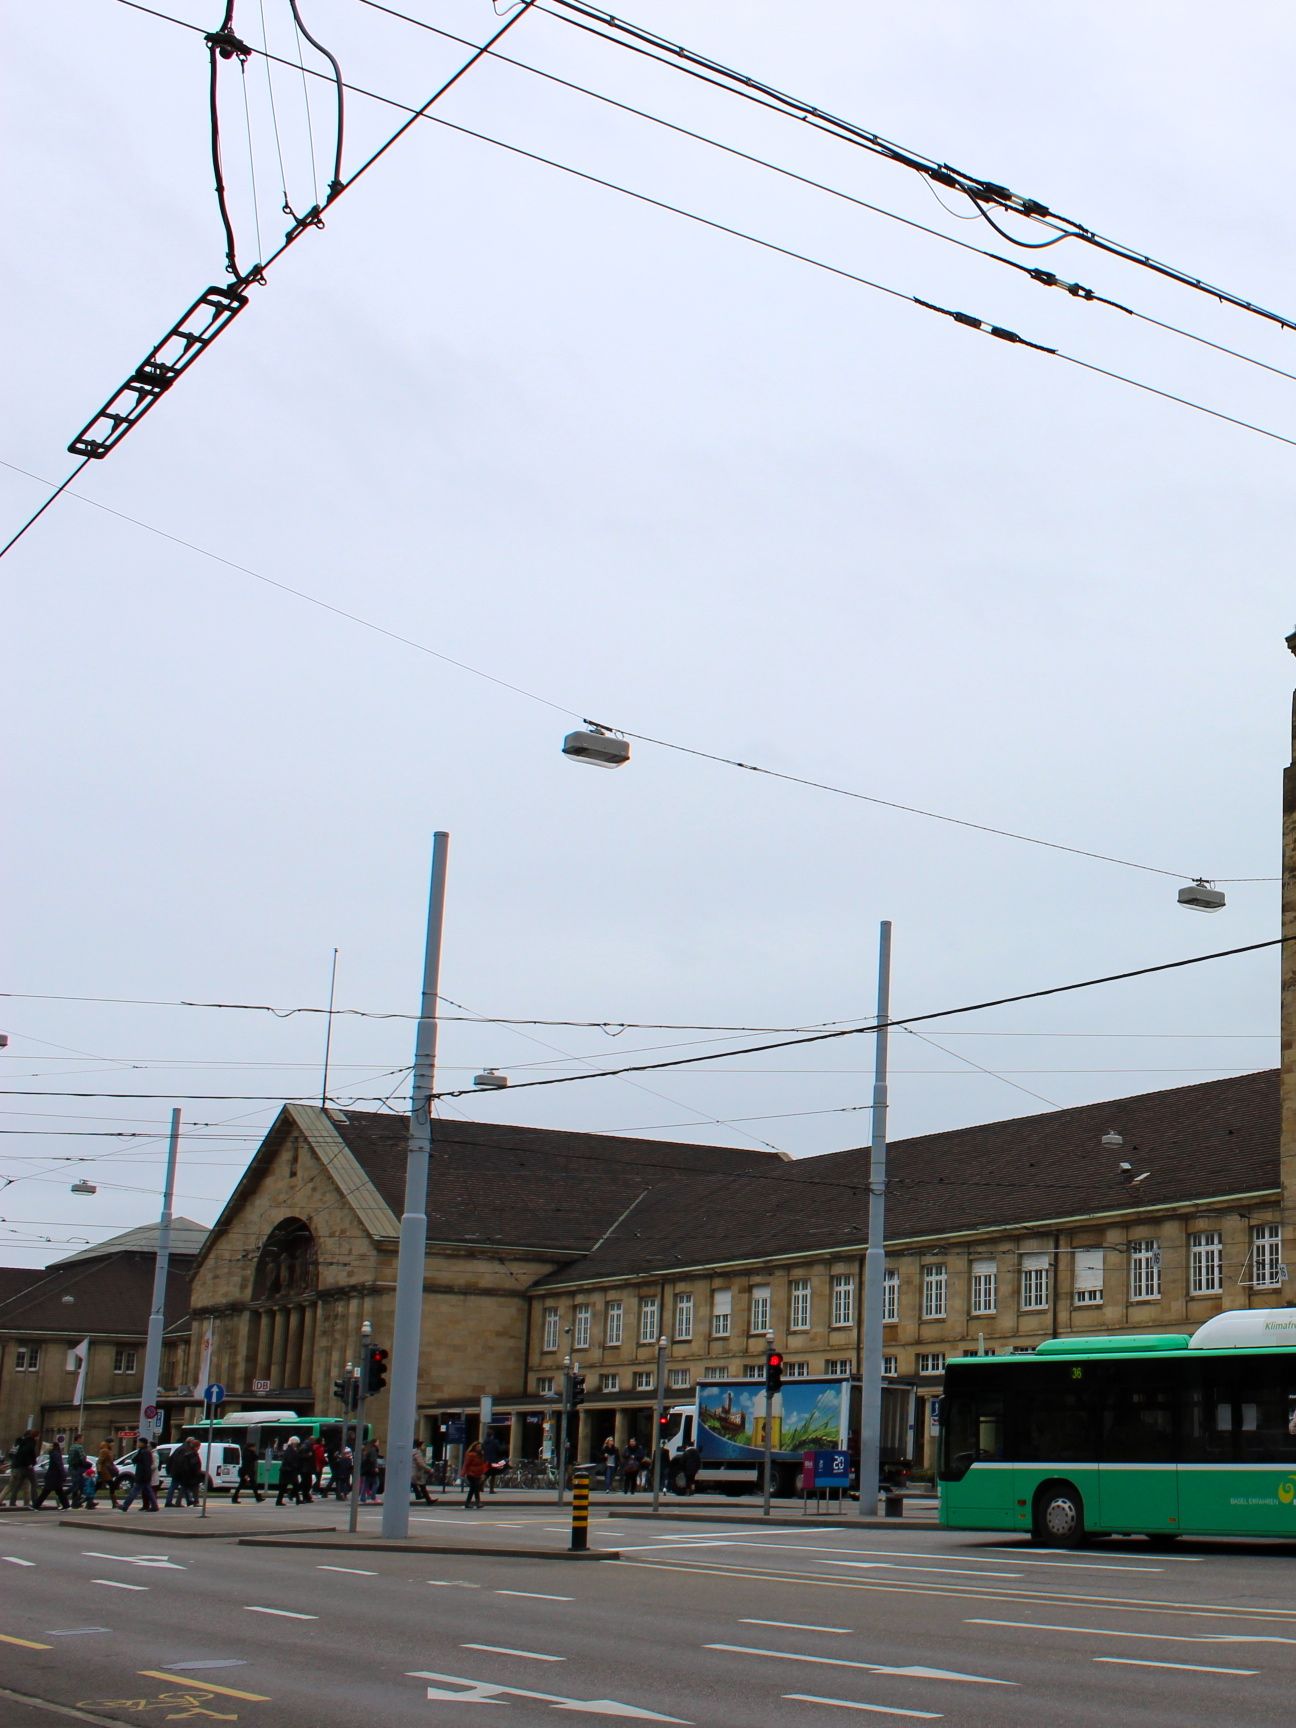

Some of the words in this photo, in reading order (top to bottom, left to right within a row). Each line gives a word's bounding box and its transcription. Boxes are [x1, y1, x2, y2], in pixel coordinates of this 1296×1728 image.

[1072, 1367, 1082, 1379] 36
[256, 1381, 269, 1390] DB
[833, 1455, 845, 1469] 20
